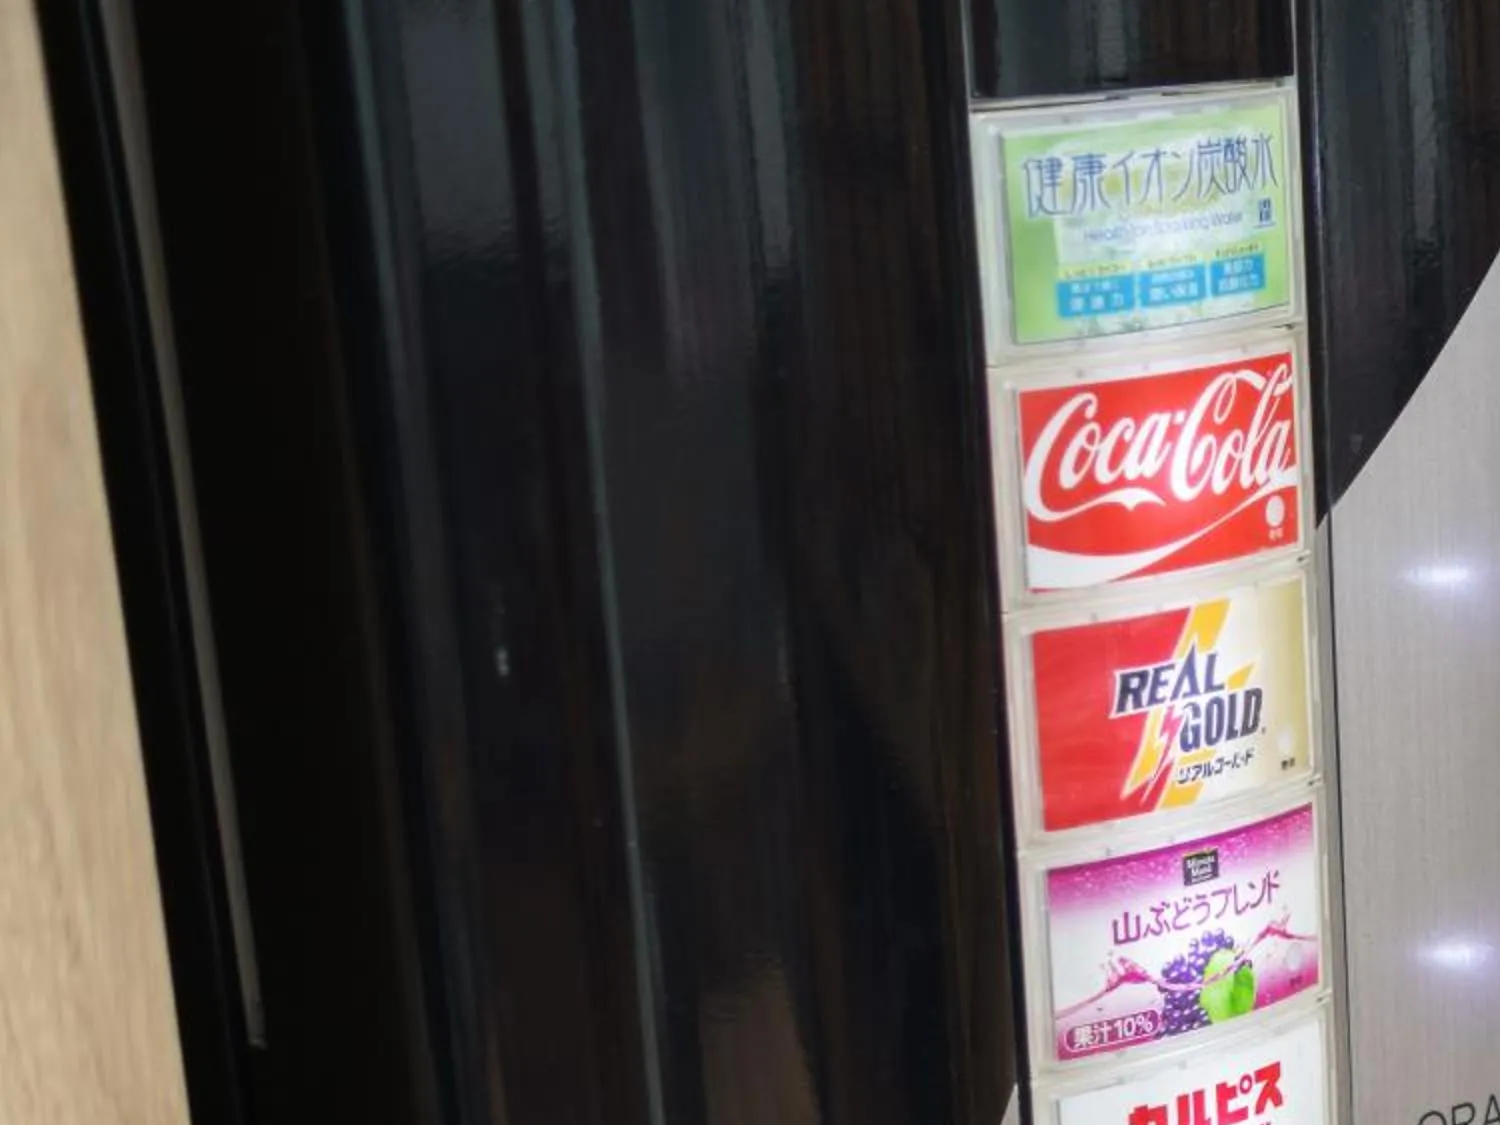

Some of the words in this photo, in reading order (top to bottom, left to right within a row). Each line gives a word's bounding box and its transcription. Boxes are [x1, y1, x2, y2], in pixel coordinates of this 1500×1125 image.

[1022, 132, 1279, 218] 健康イオン炭酸水
[1116, 641, 1224, 714] REAL
[1179, 687, 1263, 752] GOLD
[1073, 1010, 1154, 1050] 果汁10%
